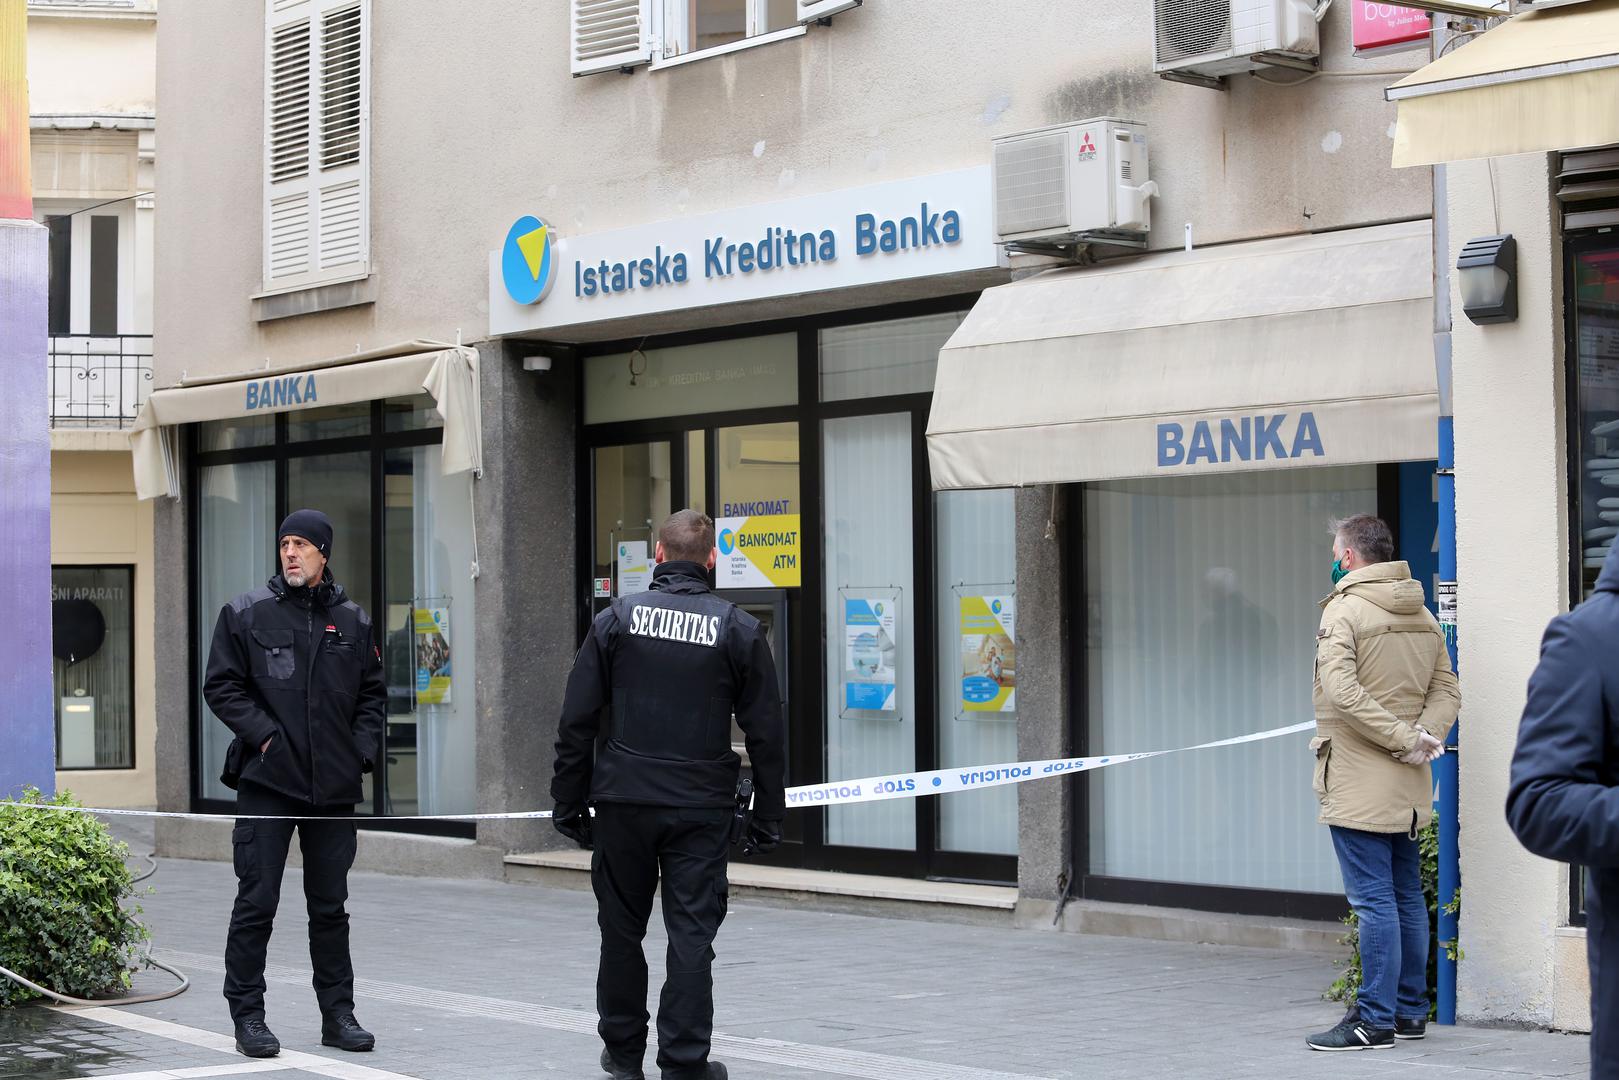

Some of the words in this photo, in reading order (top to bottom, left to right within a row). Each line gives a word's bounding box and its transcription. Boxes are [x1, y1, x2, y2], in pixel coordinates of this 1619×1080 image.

[575, 245, 688, 297] Istarska
[704, 227, 836, 278] Kreditna
[855, 202, 960, 255] Banka
[246, 374, 318, 410] BANKA
[1157, 411, 1326, 467] BANKA
[724, 500, 789, 517] BANKOMAT
[739, 531, 797, 548] BANKOMAT
[773, 554, 796, 570] ATM
[73, 587, 124, 601] APARATI
[629, 605, 719, 646] SECURITAS
[959, 766, 1032, 785] POLICIJA
[1043, 760, 1084, 773] STOP
[787, 784, 862, 803] POLICIJA
[873, 778, 916, 794] STOP
